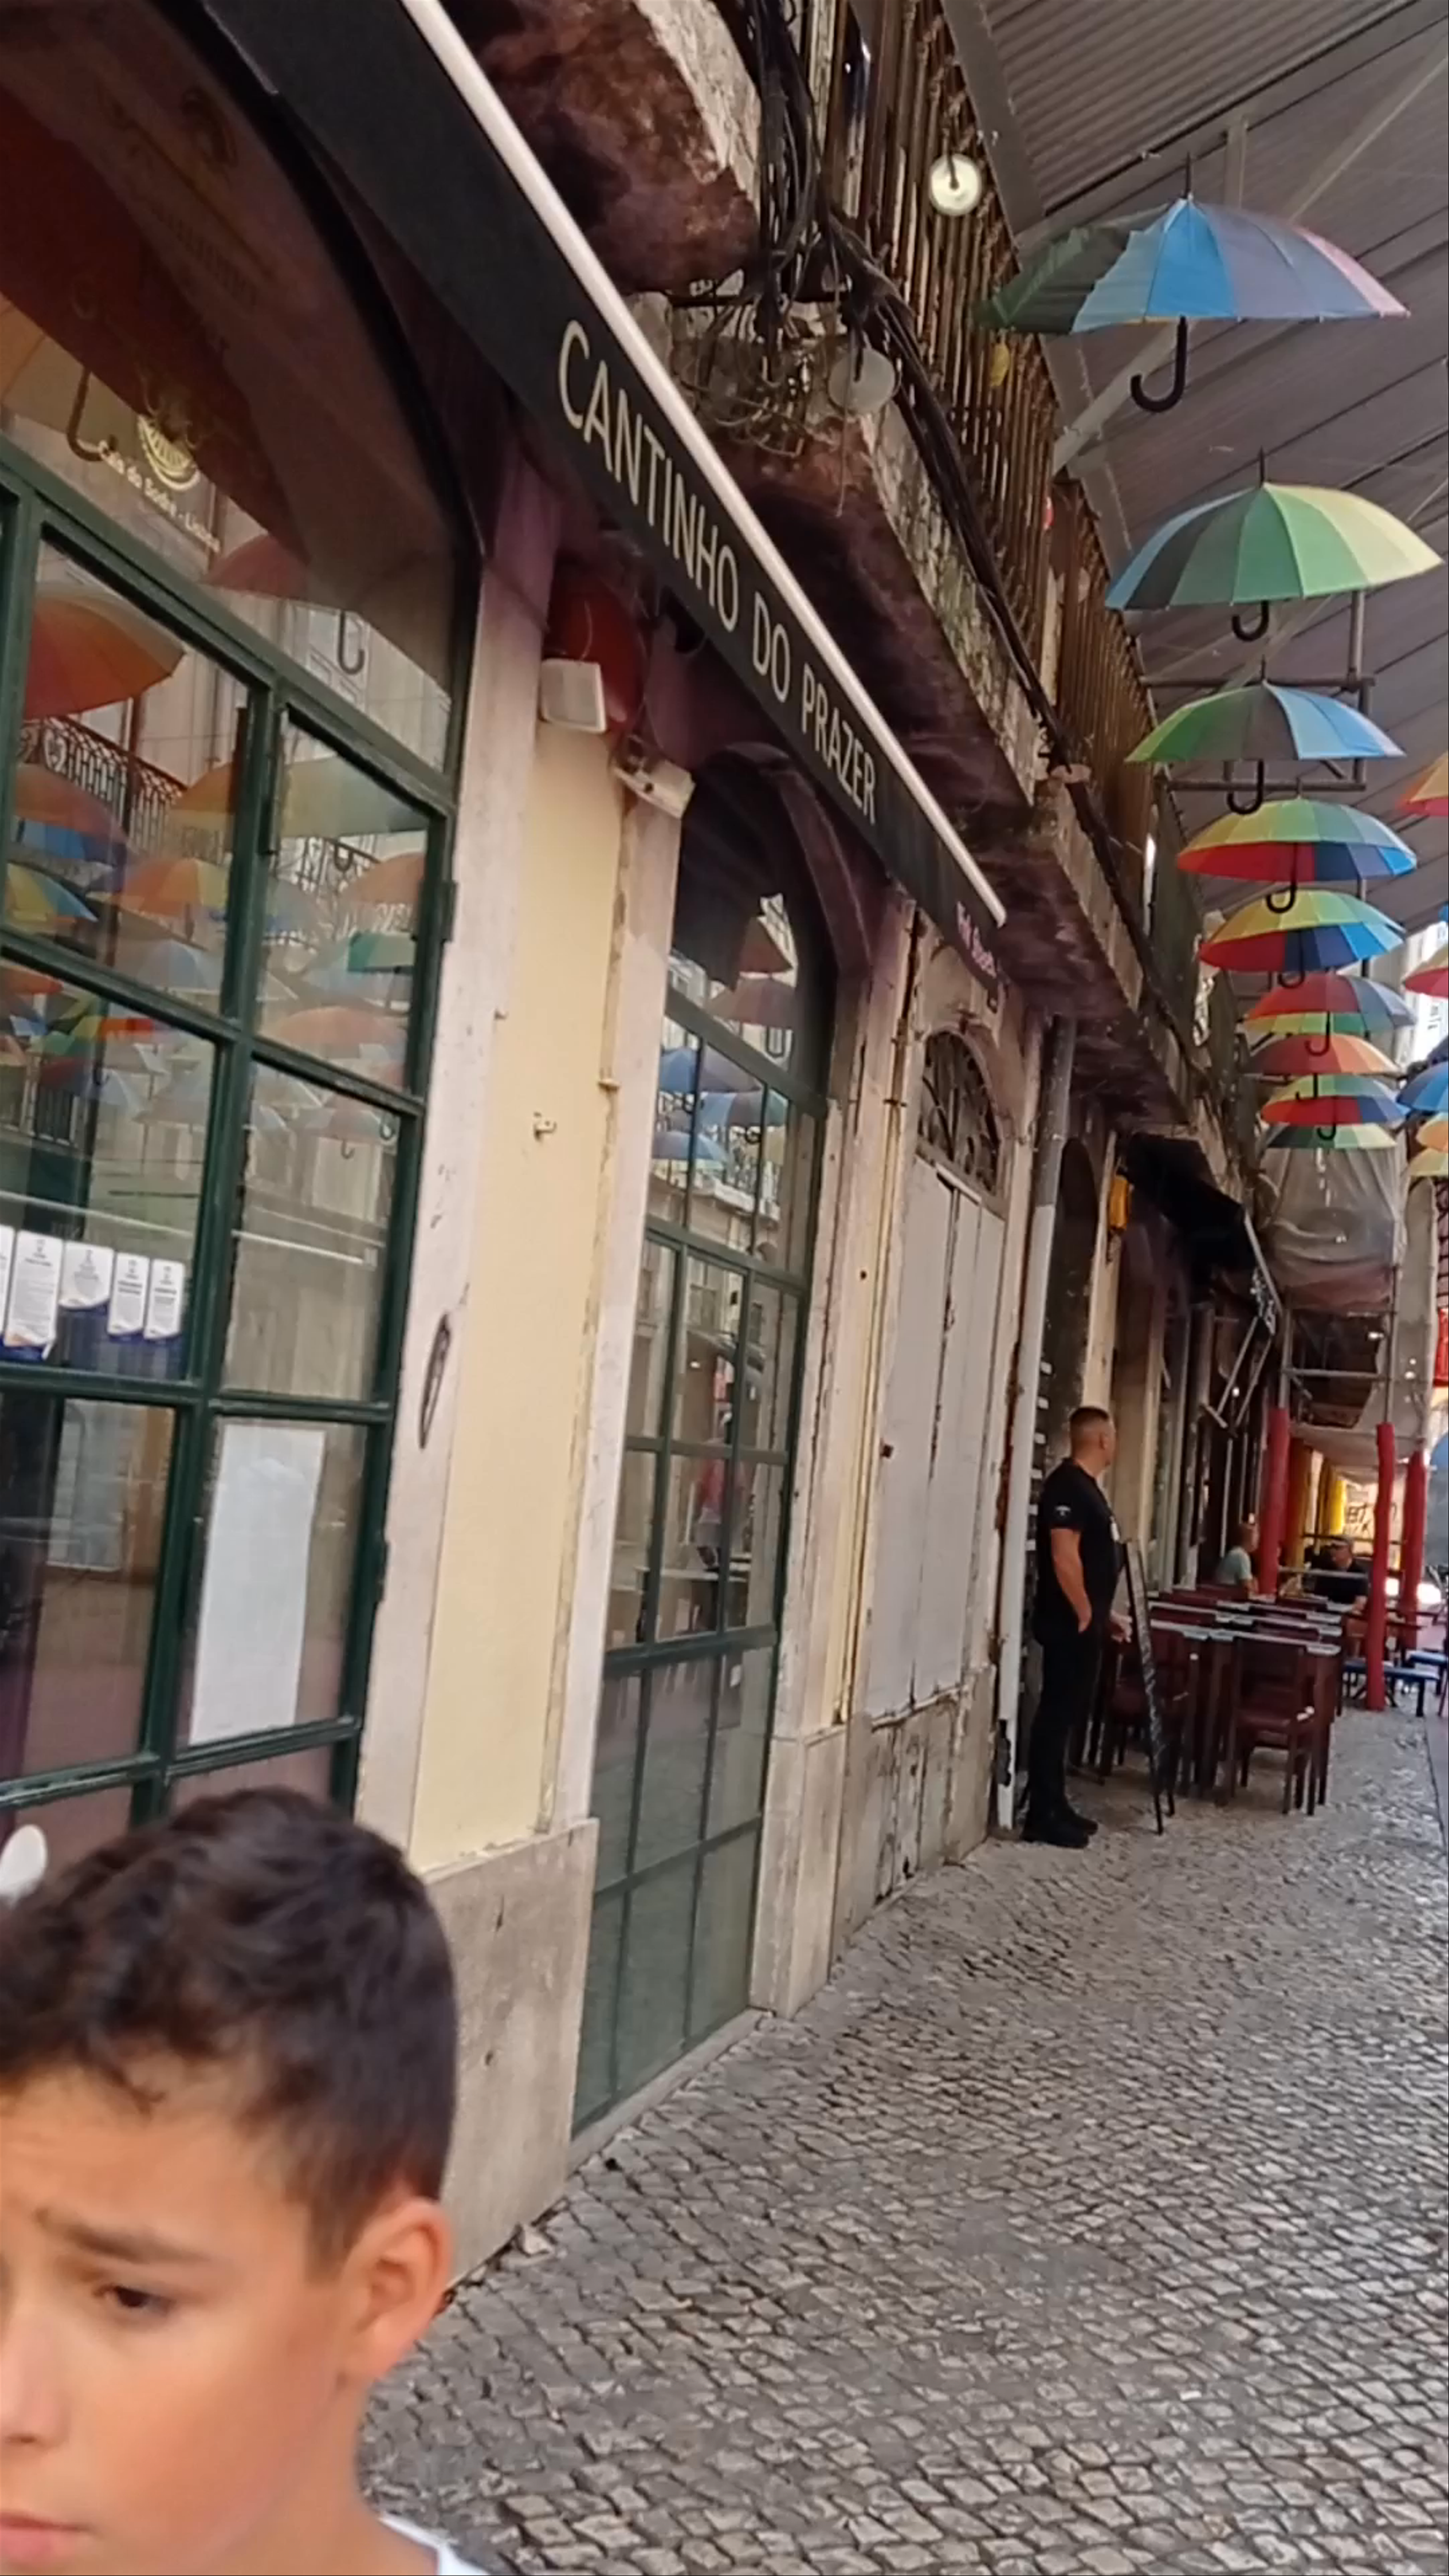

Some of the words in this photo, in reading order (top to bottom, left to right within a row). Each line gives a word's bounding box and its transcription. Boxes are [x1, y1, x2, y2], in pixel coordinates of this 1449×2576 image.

[558, 319, 739, 632] CANTINHO
[753, 591, 791, 703] DO
[801, 662, 876, 825] PRAZER
